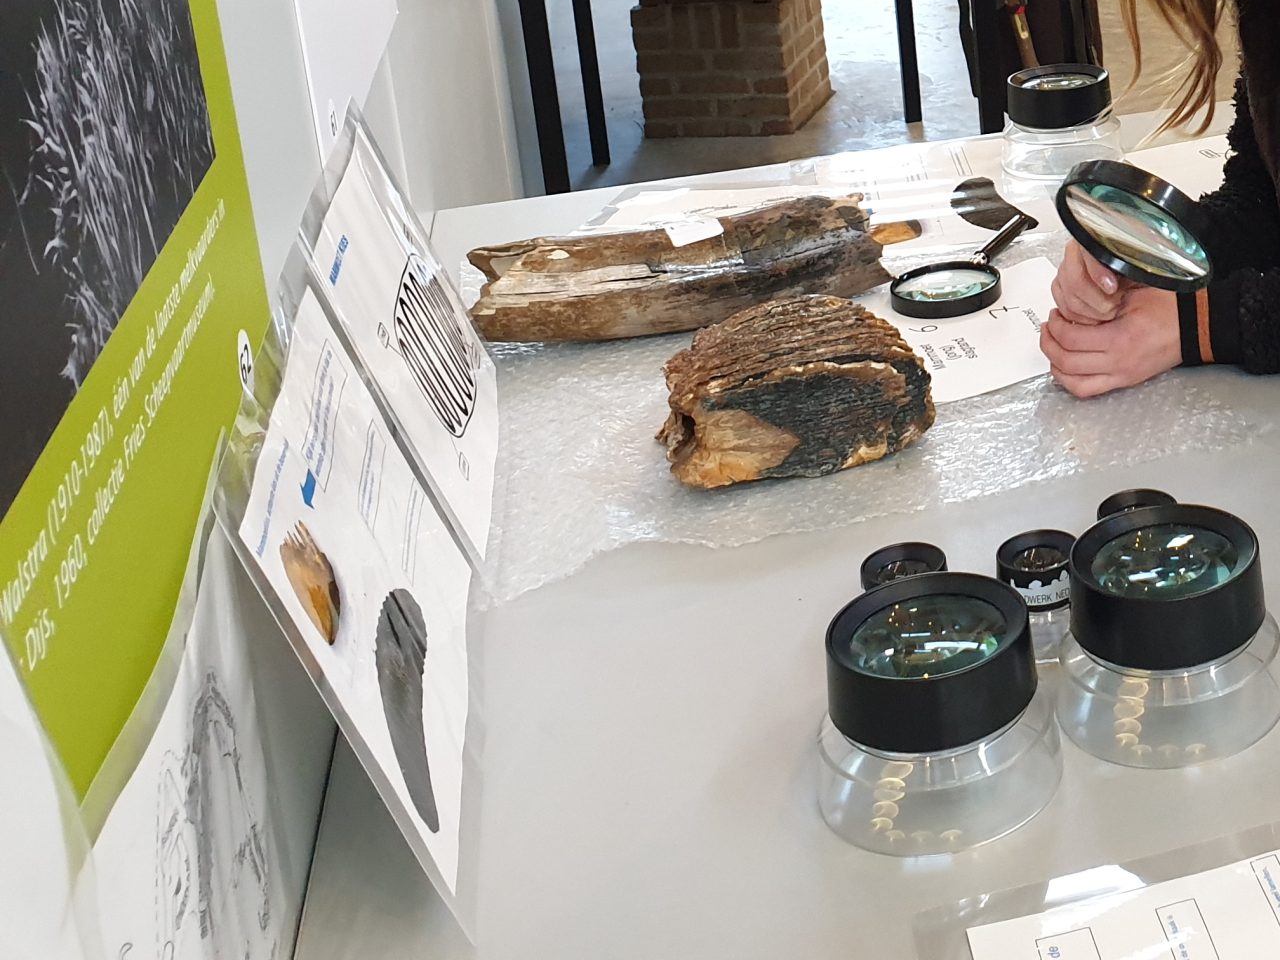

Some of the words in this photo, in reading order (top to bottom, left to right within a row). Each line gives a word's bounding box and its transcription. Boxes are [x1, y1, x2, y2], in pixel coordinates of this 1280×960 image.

[129, 346, 146, 389] van
[145, 324, 157, 360] de
[240, 343, 251, 384] 62
[55, 534, 88, 609] 1960,
[87, 457, 125, 545] collectie
[124, 414, 146, 470] Fries
[1024, 594, 1053, 605] DWERK
